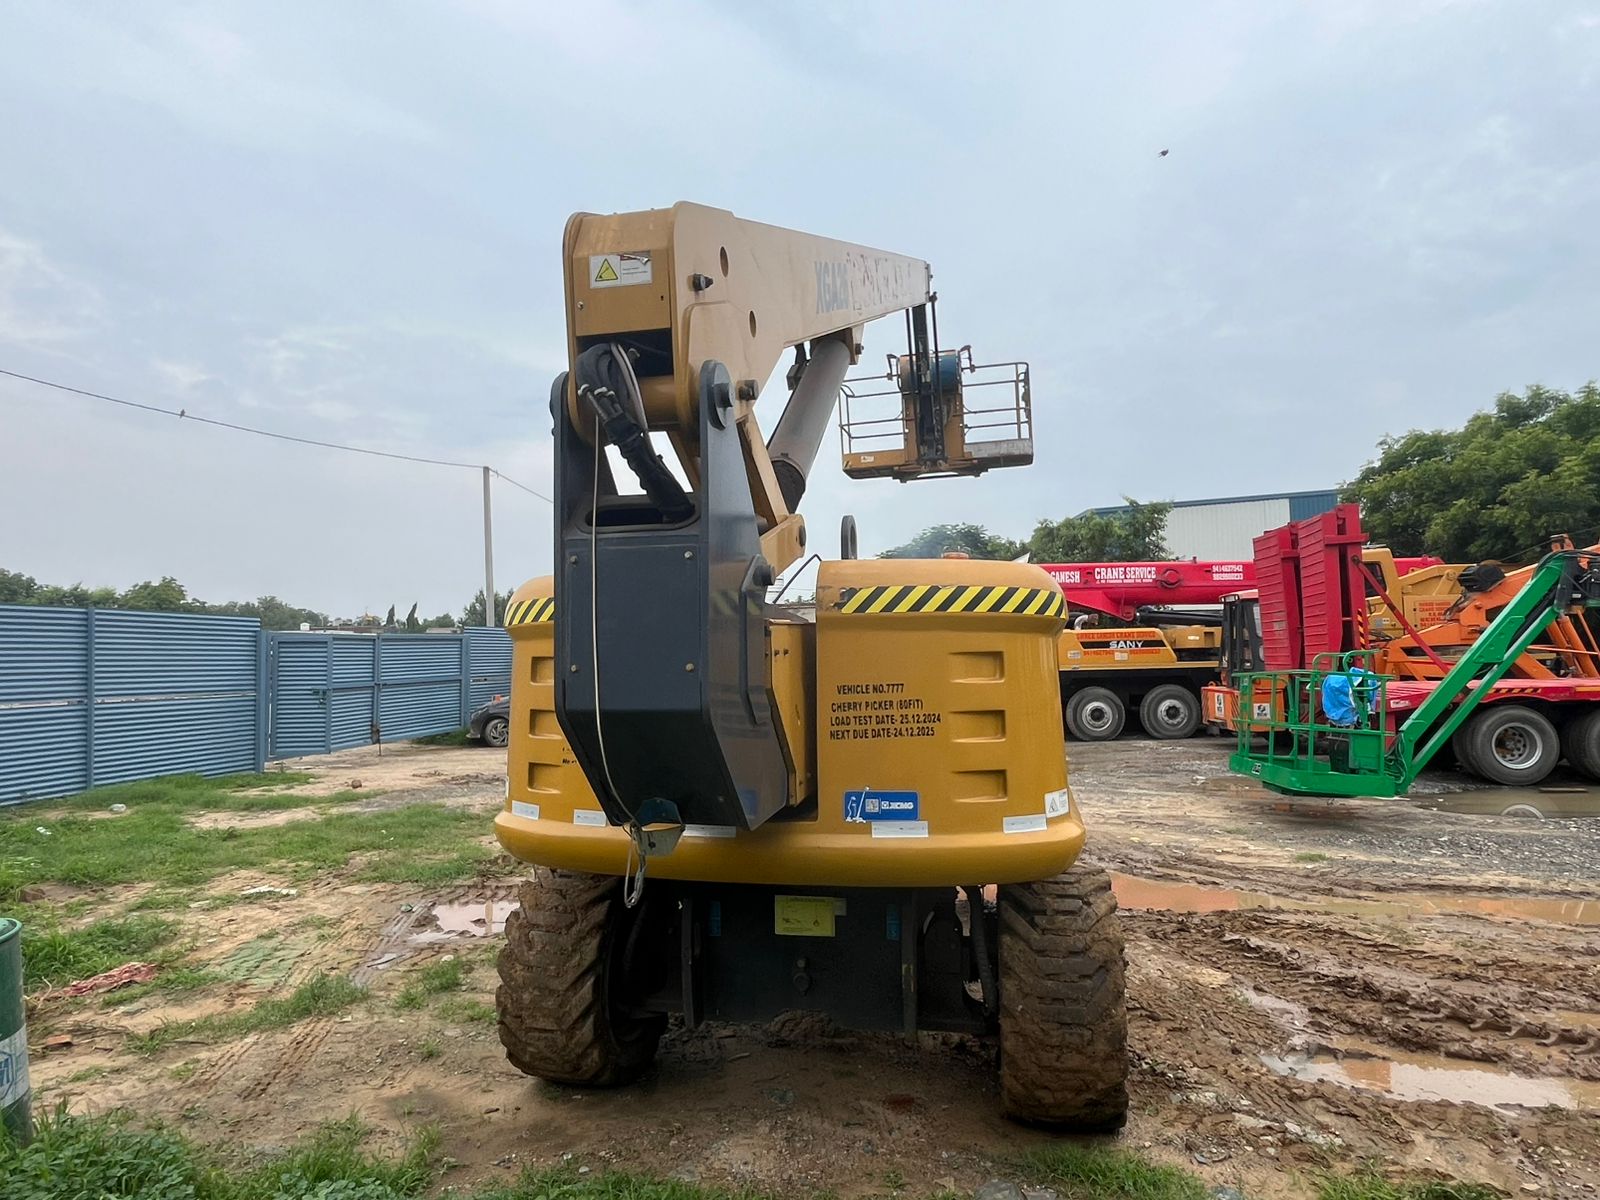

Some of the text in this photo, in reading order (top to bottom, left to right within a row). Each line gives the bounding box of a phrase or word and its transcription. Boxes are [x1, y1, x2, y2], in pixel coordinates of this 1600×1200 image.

[1095, 568, 1125, 580] CRANE
[1126, 567, 1156, 579] SERVICE
[1109, 640, 1144, 649] SANY
[837, 684, 870, 695] VEHICLE
[831, 701, 863, 713] CHERRY
[865, 700, 894, 711] PICKER
[830, 716, 851, 727] LOAD
[853, 715, 873, 726] TEST
[900, 713, 942, 724] 25.12.2024
[830, 729, 851, 740] NEXT
[853, 729, 869, 739] DUE
